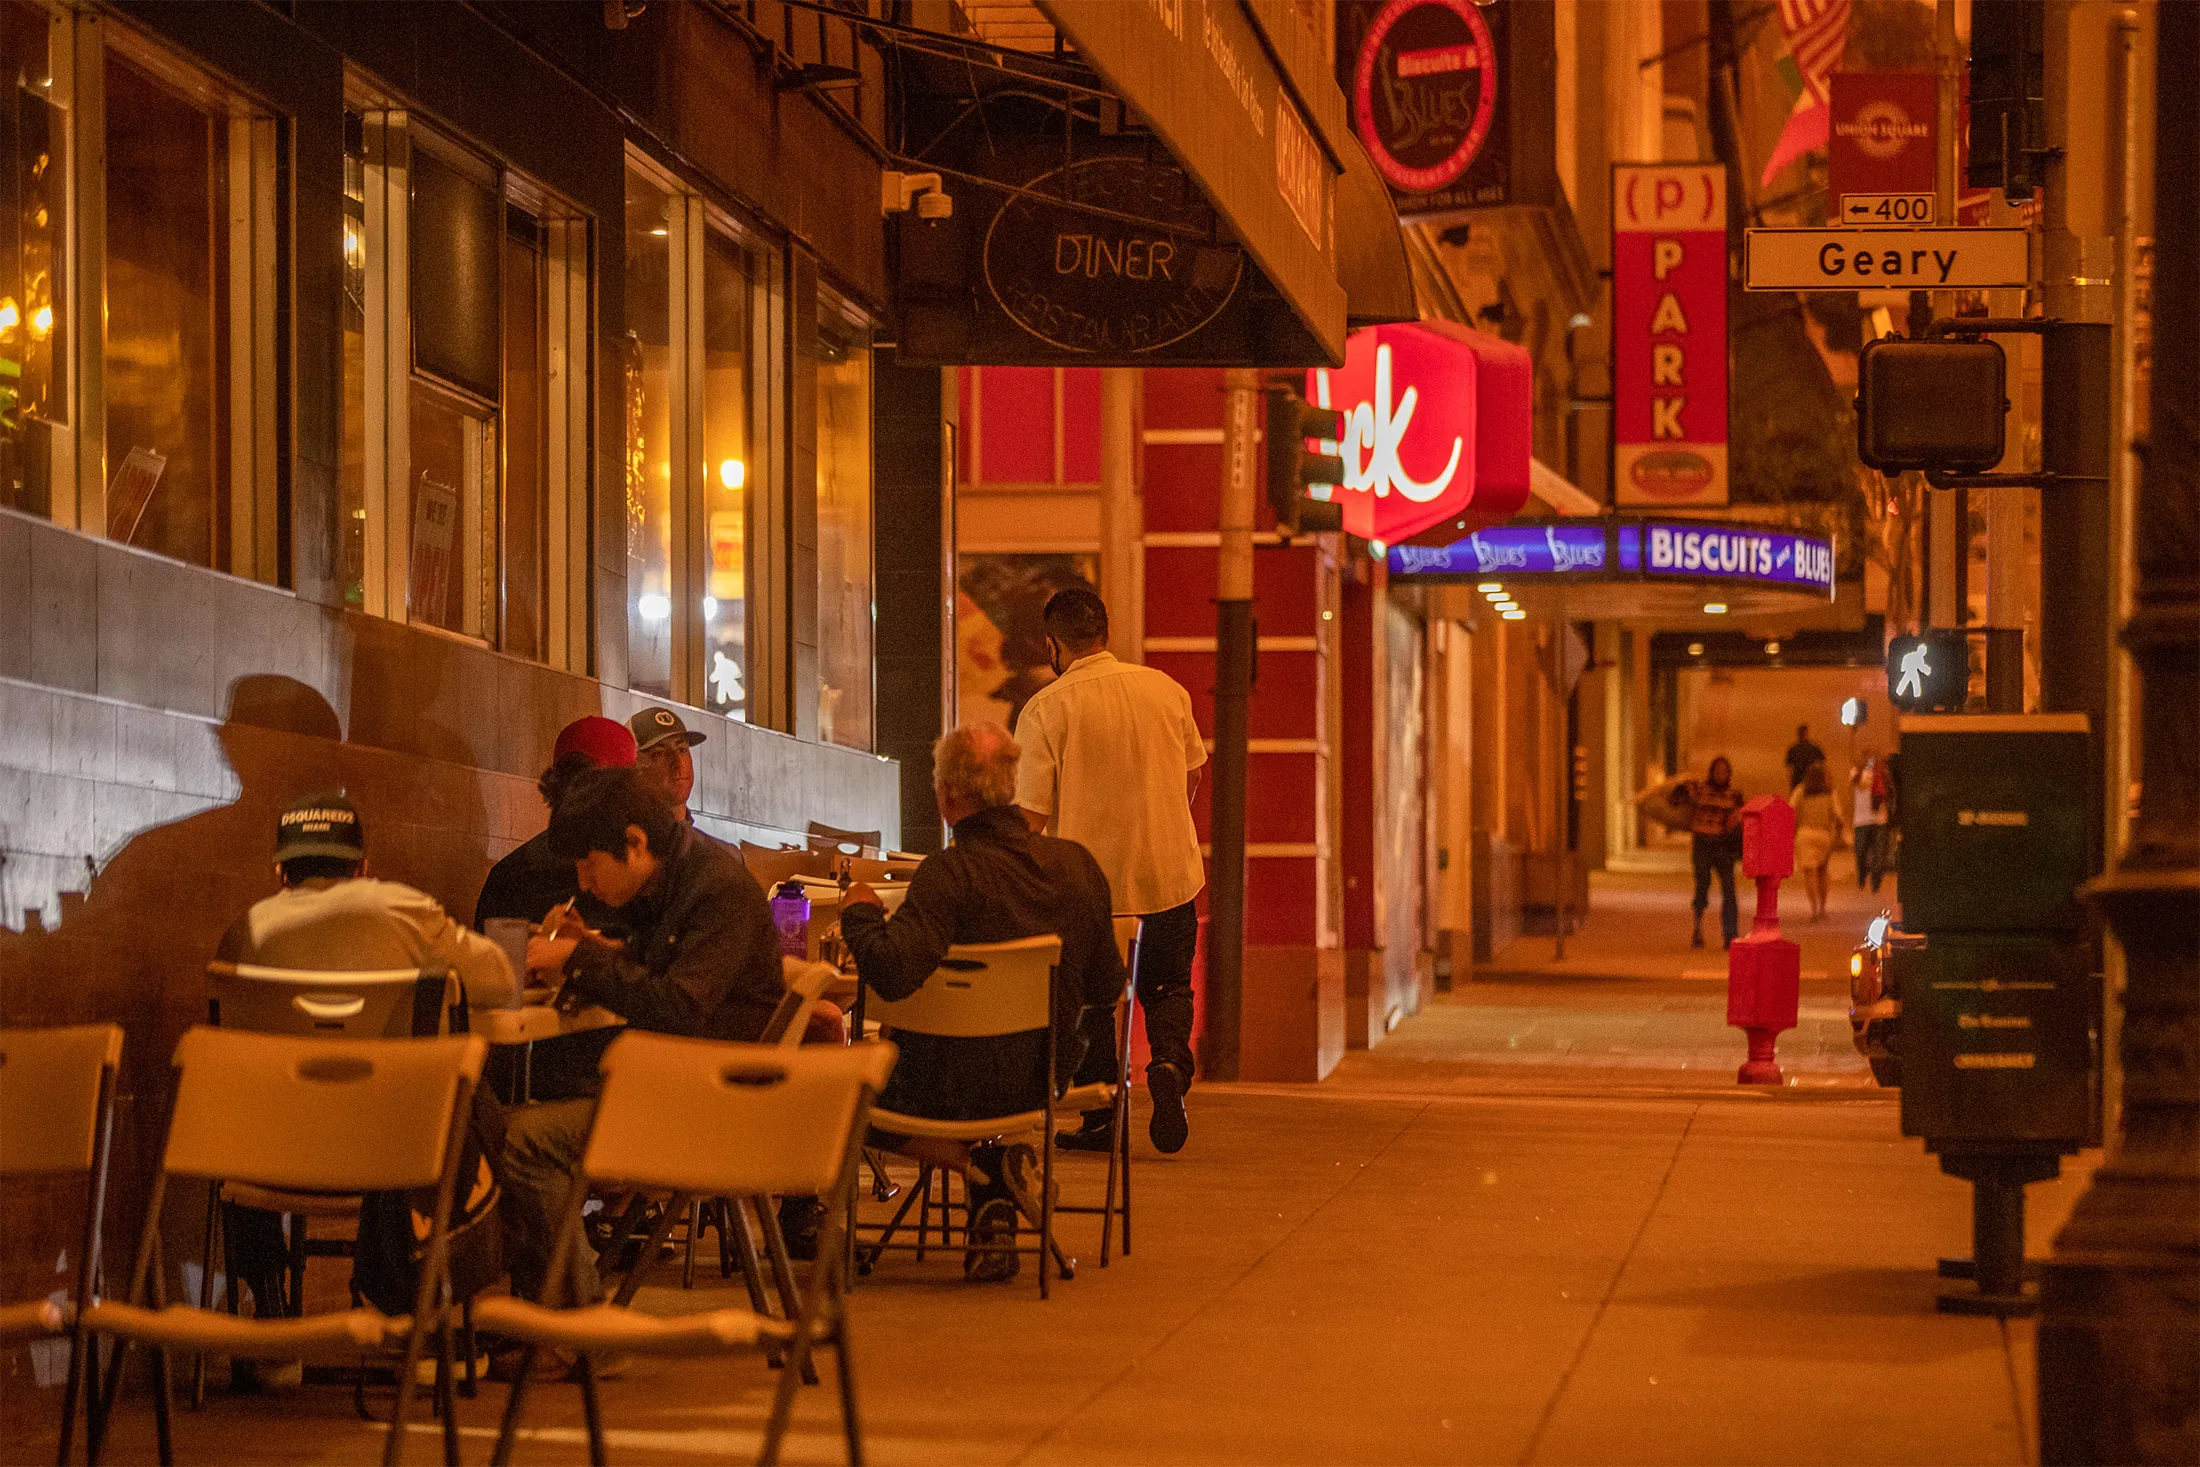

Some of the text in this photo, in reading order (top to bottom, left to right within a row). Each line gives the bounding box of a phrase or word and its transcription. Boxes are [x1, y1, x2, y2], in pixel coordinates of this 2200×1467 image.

[1874, 198, 1928, 221] 400
[1055, 233, 1174, 281] DINER
[1818, 242, 1957, 283] Geary
[1650, 237, 1688, 440] PARK
[1651, 527, 1773, 575] BISCUITS
